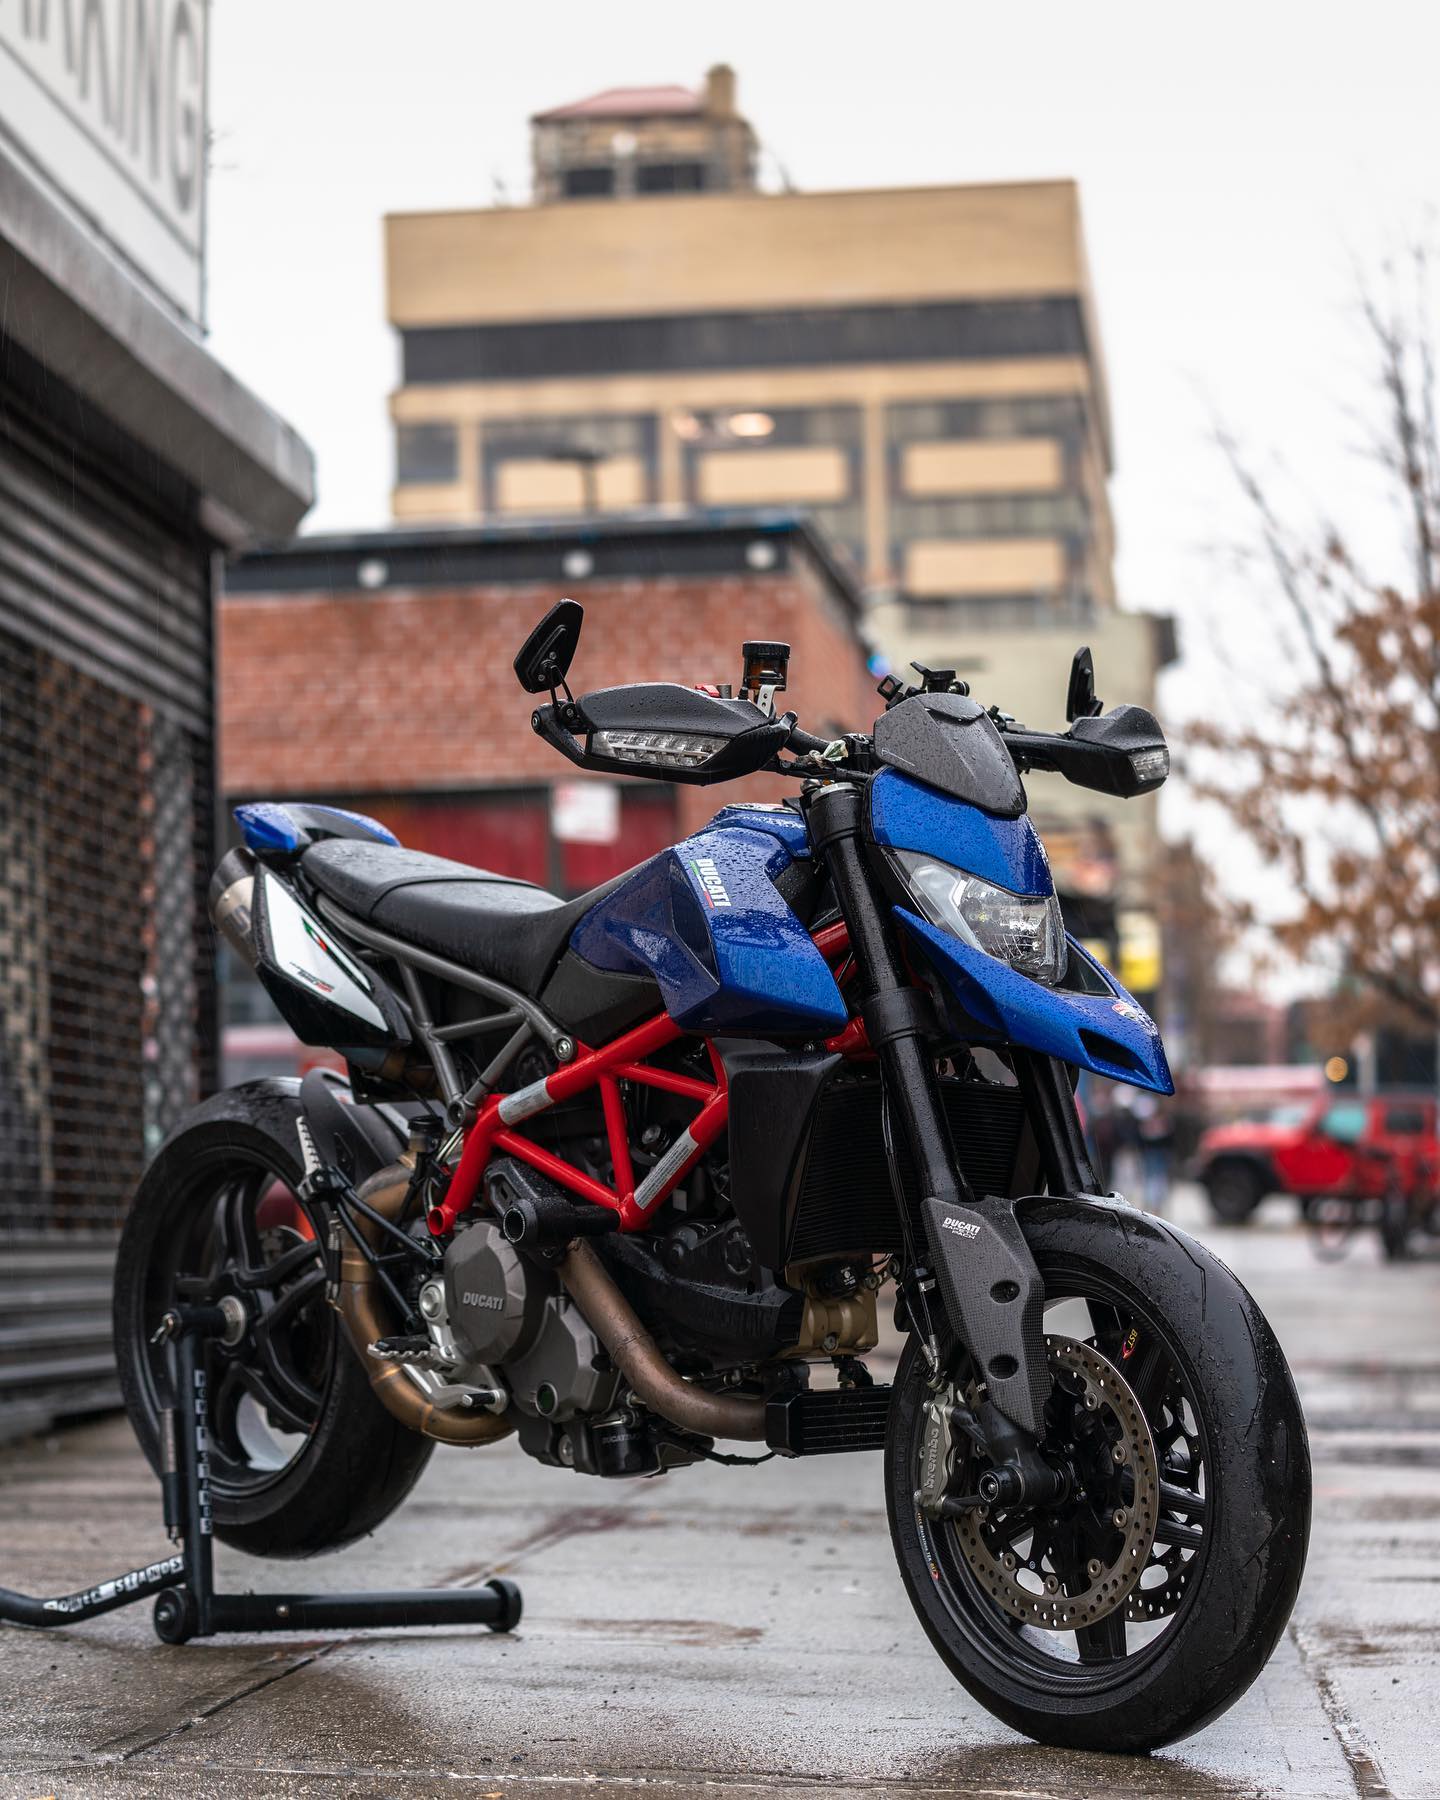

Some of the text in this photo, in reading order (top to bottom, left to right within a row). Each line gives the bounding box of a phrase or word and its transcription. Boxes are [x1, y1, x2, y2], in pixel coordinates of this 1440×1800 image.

[696, 859, 731, 907] DUCATI
[943, 1217, 980, 1234] DUCATI
[463, 1291, 504, 1311] DUCATI
[1128, 1329, 1138, 1348] BST
[923, 1427, 939, 1489] brembo
